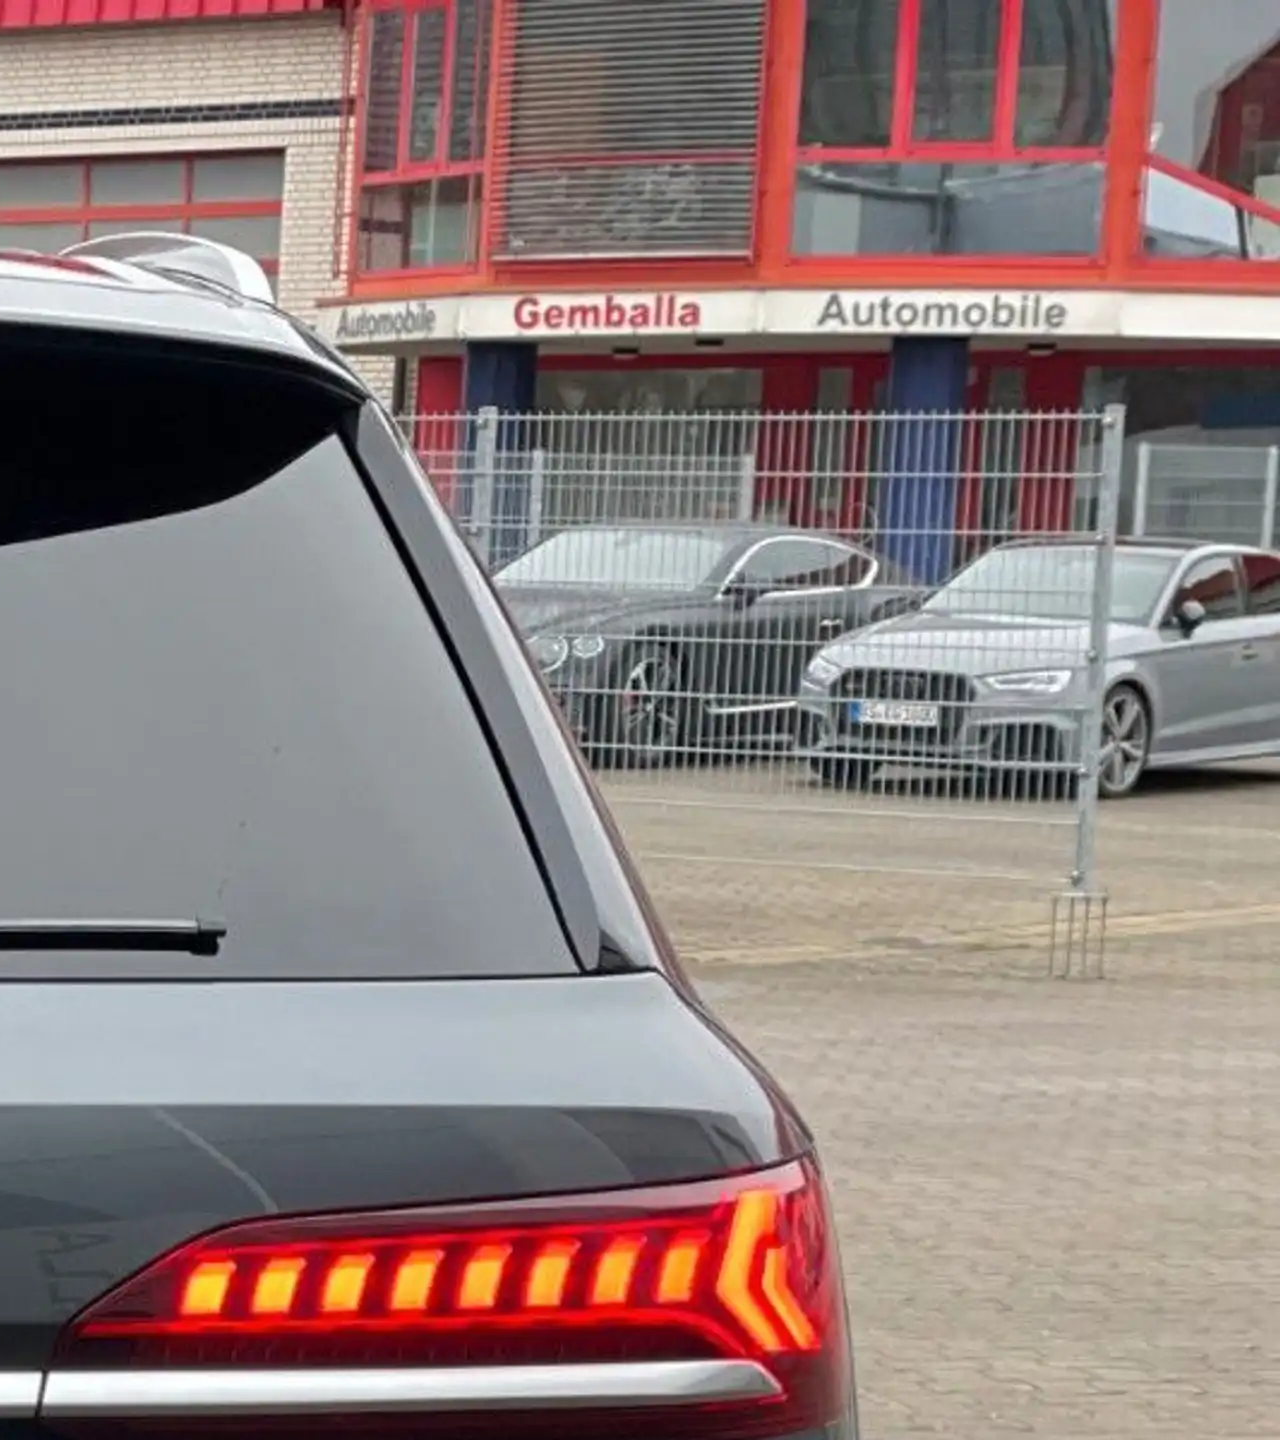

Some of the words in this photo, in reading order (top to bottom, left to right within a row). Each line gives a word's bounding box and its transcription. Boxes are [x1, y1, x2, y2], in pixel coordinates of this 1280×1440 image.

[336, 302, 437, 337] Automobile
[513, 294, 701, 331] Gemballa
[817, 293, 1068, 328] Automobile
